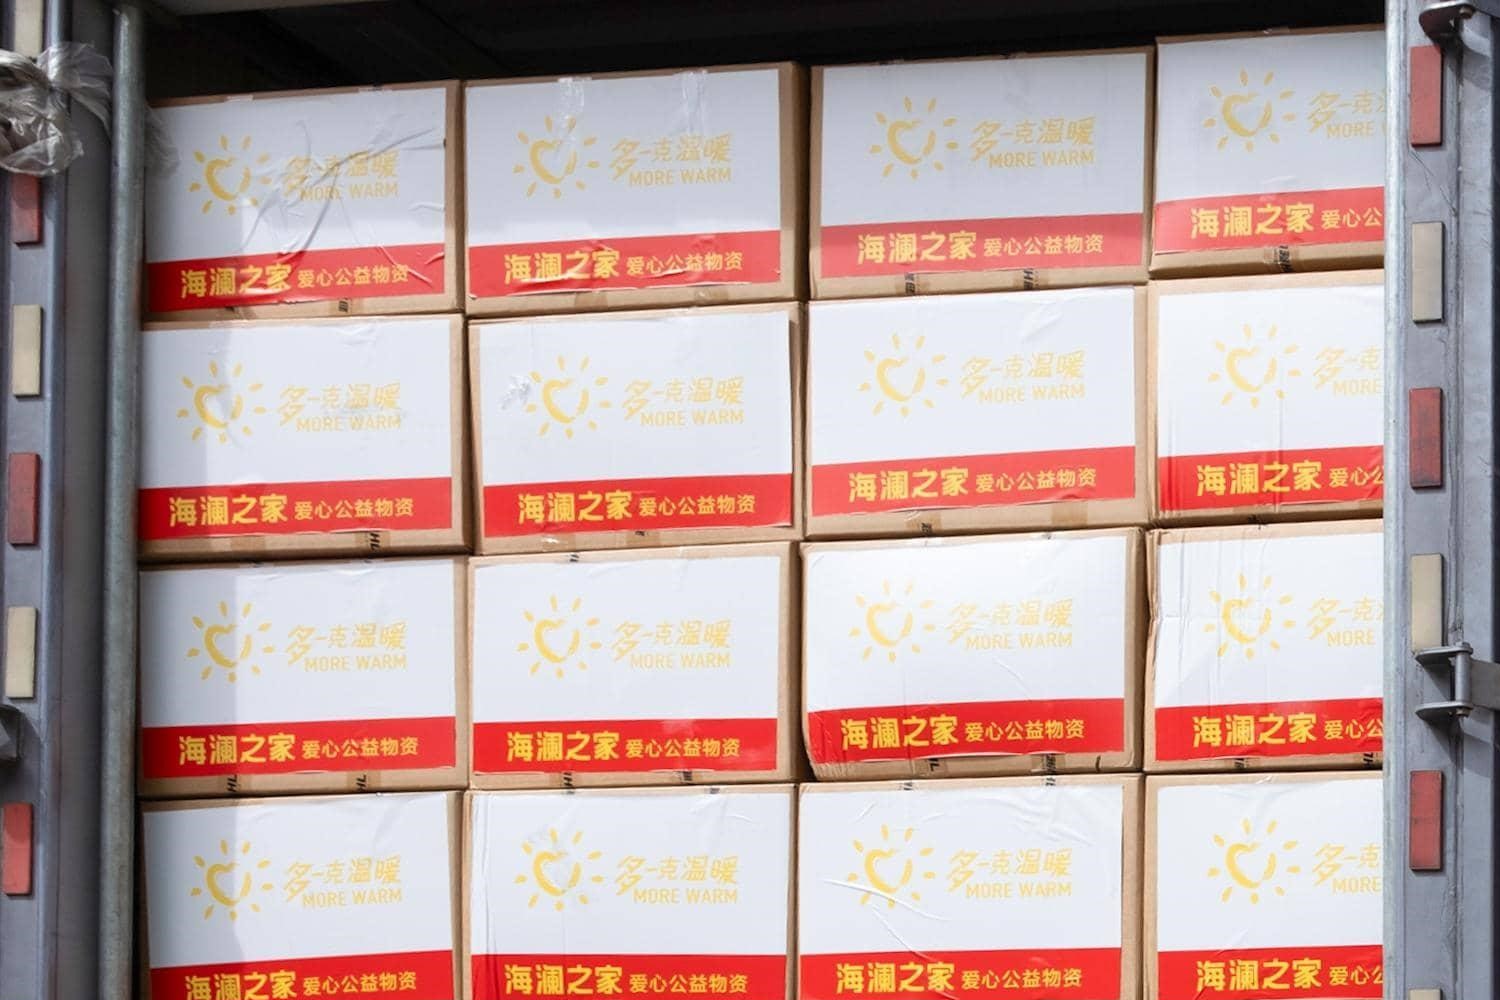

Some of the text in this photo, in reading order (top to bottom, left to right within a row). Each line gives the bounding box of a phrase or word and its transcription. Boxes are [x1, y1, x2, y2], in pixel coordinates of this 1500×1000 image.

[1327, 121, 1373, 139] MORE
[988, 149, 1094, 169] MORE WARM
[350, 180, 398, 199] WARM
[628, 166, 732, 187] MORE WARM
[1190, 201, 1314, 239] 海澜之家
[857, 229, 1104, 265] 海澜之家 爱心公益物资
[504, 248, 743, 285] 海澜之家 爱心公益物资
[180, 262, 409, 299] 海澜之家 爱心公益物资
[978, 382, 1085, 405] MORE WARM
[1333, 378, 1381, 396] MORE
[296, 414, 401, 433] MORE WARM
[640, 408, 743, 428] MORE WARM
[848, 466, 1097, 503] 海澜之家 爱心公益物资
[1196, 459, 1322, 497] 海澜之家
[168, 493, 414, 527] 海澜之家 爱心公益物资
[517, 489, 755, 524] 海澜之家 爱心公益物资
[1307, 596, 1383, 640] 多一克
[966, 631, 1072, 652] MORE WARM
[1327, 629, 1376, 647] MORE
[303, 653, 407, 673] MORE WARM
[630, 652, 730, 670] MORE WARM
[839, 714, 1085, 750] 海澜之家 爱心公益物资
[1192, 711, 1317, 748] 海澜之家
[178, 732, 419, 766] 海澜之家 爱心公益物资
[506, 730, 740, 762] 海澜之家 爱心公益物资
[302, 887, 402, 909] MORE WARM
[633, 888, 738, 904] MORE WARM
[965, 881, 1072, 899] MORE WARM
[1332, 876, 1382, 894] MORE
[303, 970, 417, 997] 爱心公益物资
[504, 964, 748, 995] 海澜之家 爱心公益物资
[836, 961, 1082, 994] 海澜之家 爱心公益物资
[1196, 957, 1321, 992] 海澜之家
